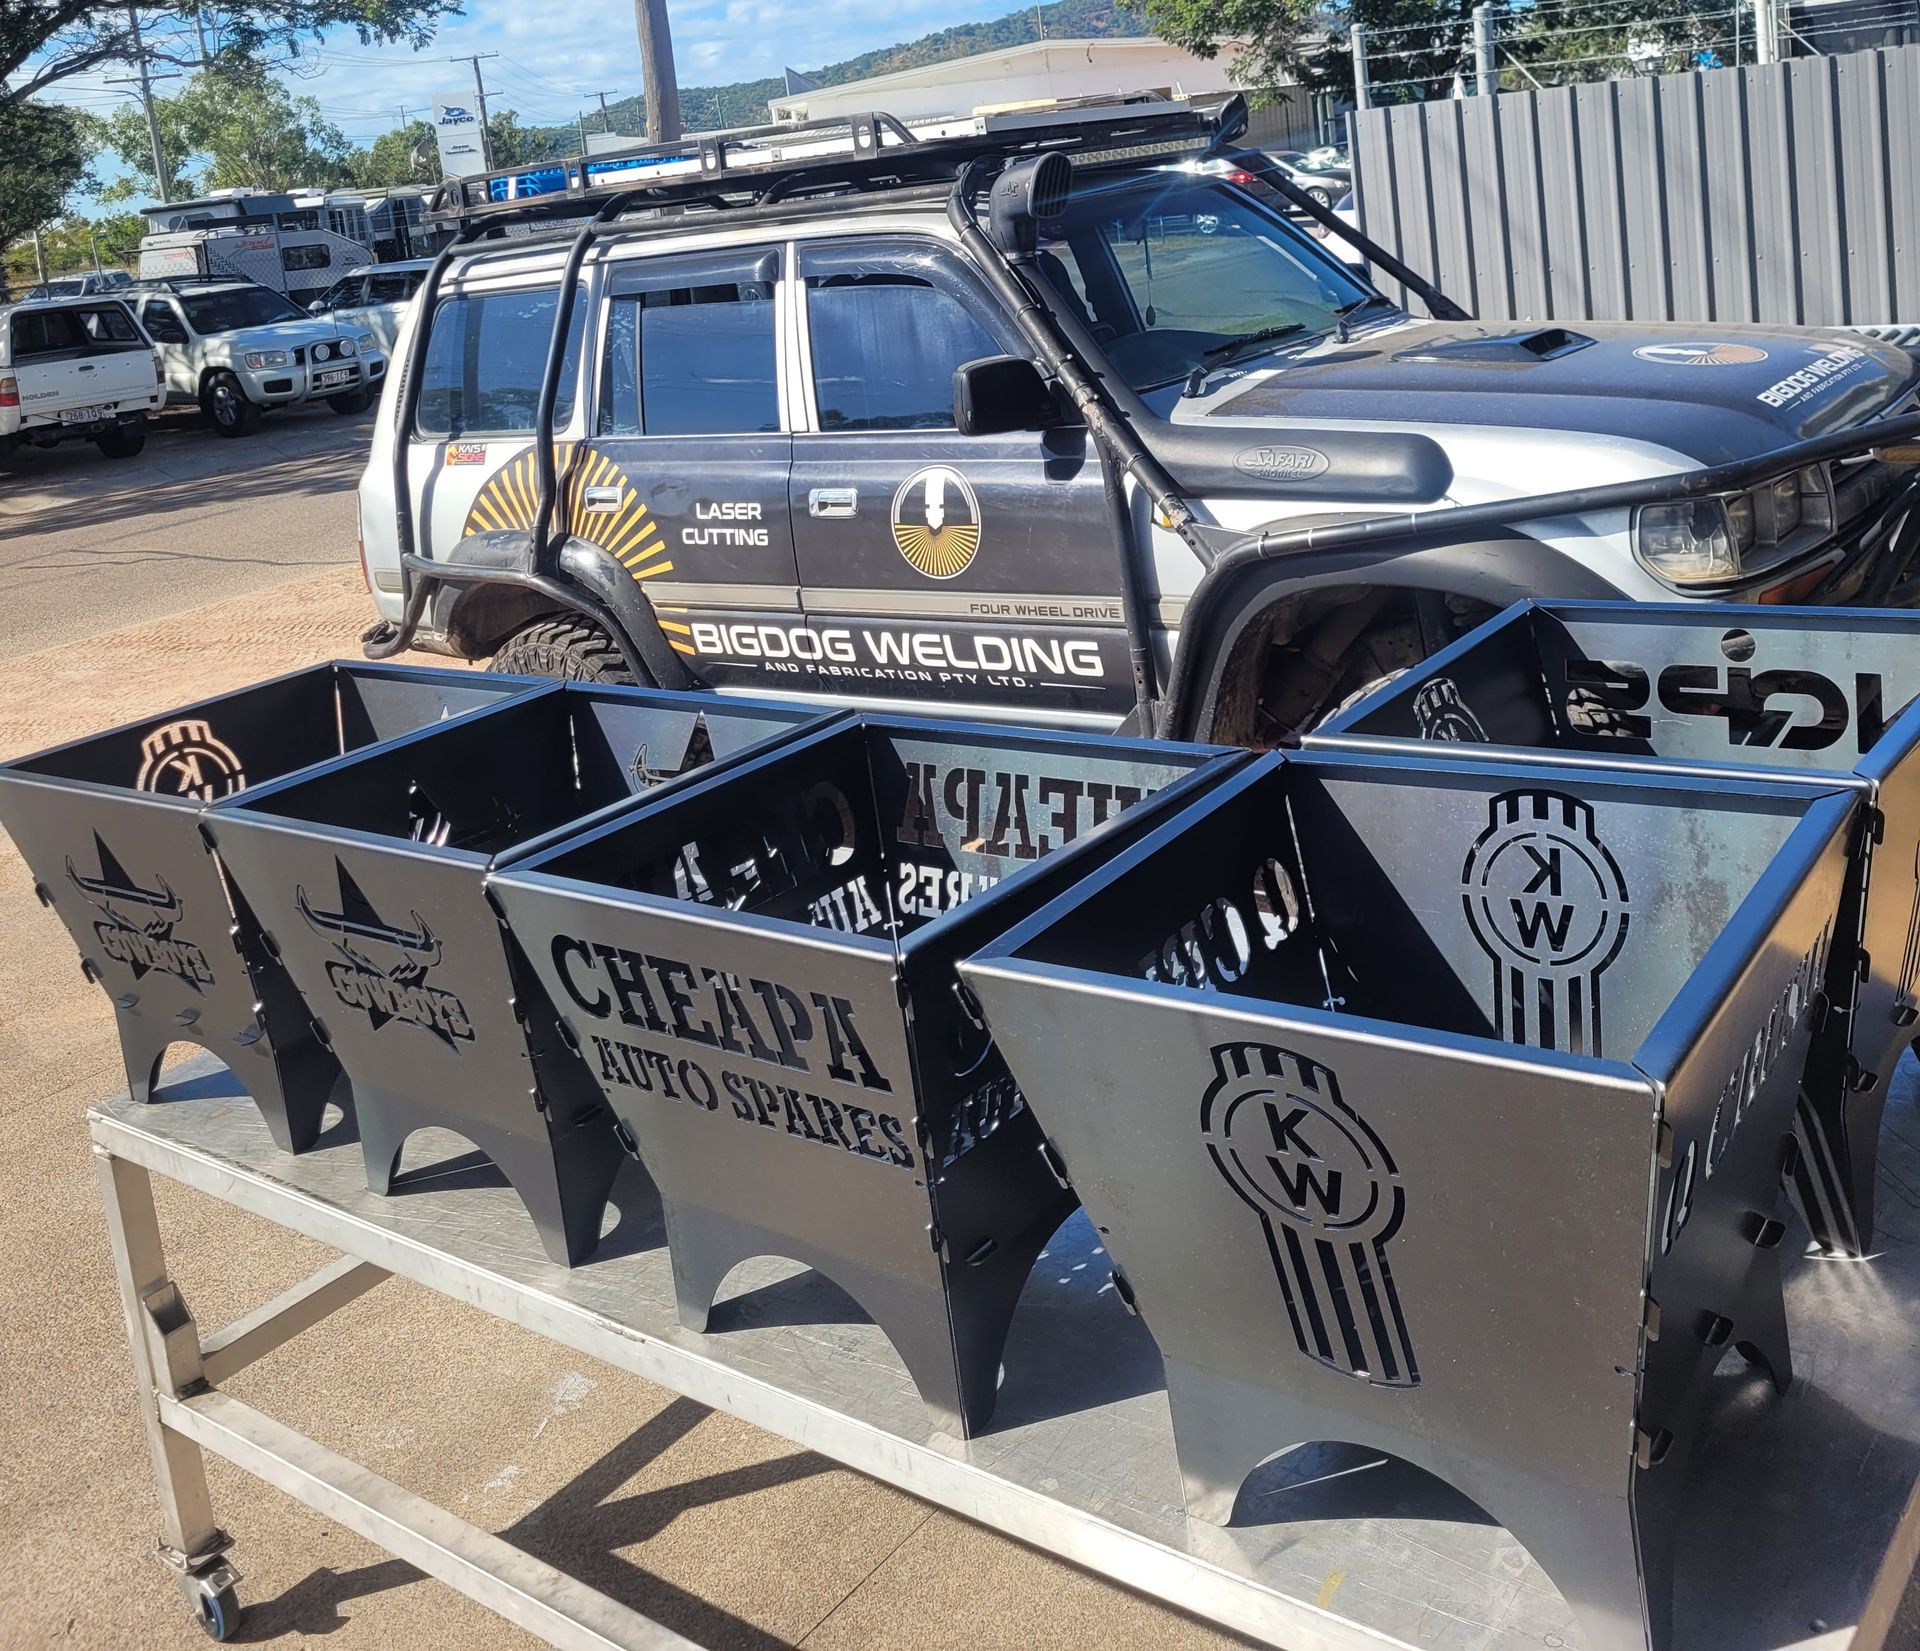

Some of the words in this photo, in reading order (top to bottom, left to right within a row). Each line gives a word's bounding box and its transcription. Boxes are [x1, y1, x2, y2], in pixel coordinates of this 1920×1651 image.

[438, 116, 474, 126] Jayco
[1756, 369, 1820, 408] BIGDOG
[1804, 346, 1865, 378] WELDING
[22, 390, 60, 401] HOLDEN
[1245, 449, 1316, 469] SAFARI
[1257, 468, 1304, 479] SNORKEL
[695, 502, 763, 520] LASER
[682, 528, 769, 546] CUTTING
[970, 603, 1011, 615] FOUR
[1014, 605, 1070, 617] WHEEL
[1072, 606, 1121, 618] DRIVE
[691, 623, 857, 663] BIGDOG
[862, 630, 1105, 677] WELDING
[764, 661, 800, 673] AND
[806, 664, 933, 682] FABRICATION
[939, 672, 977, 685] PTY
[987, 674, 1034, 688] LTD.
[550, 934, 895, 1096] CHEAPA
[591, 1035, 719, 1111] AUTO
[721, 1071, 916, 1170] SPARES
